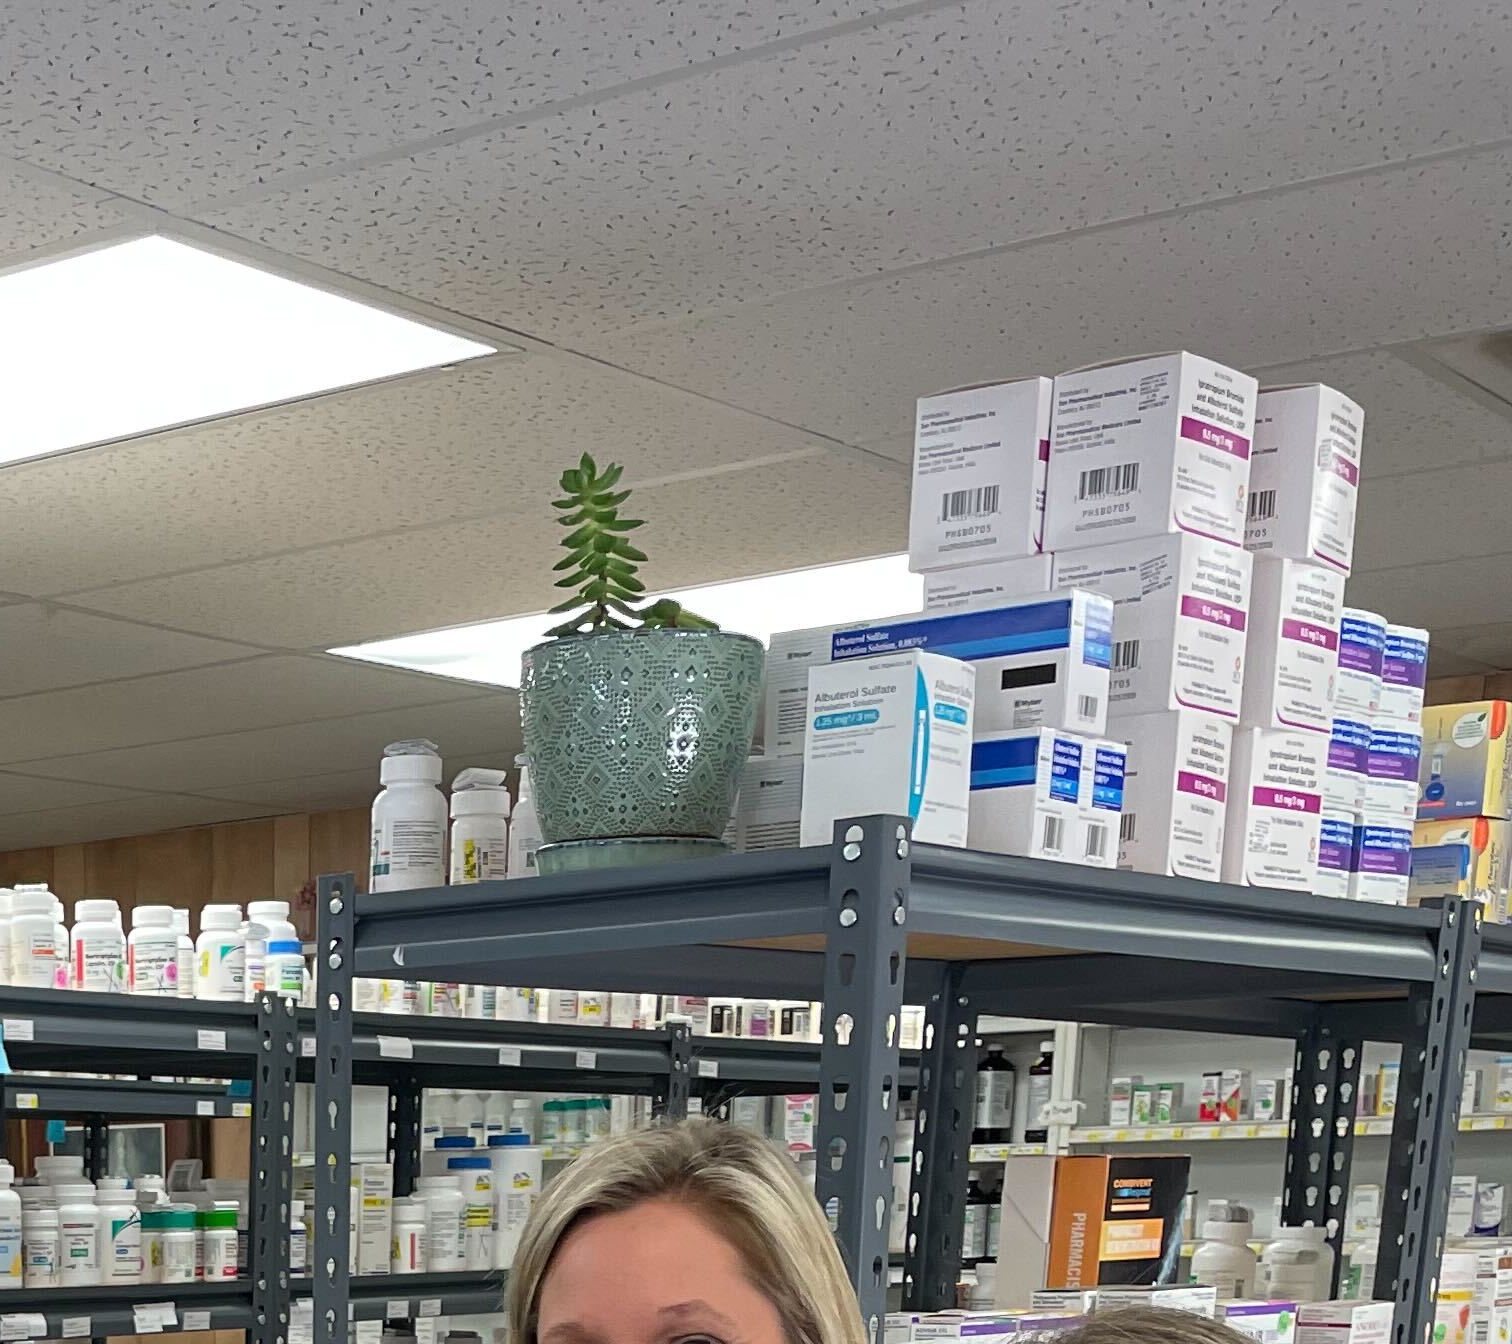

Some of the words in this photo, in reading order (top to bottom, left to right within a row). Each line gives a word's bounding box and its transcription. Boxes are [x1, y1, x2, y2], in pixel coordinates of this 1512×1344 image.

[815, 688, 859, 703] Albuterol
[861, 683, 897, 698] Sulfate
[1109, 678, 1131, 690] 705
[1065, 1212, 1088, 1288] PHARMACIS
